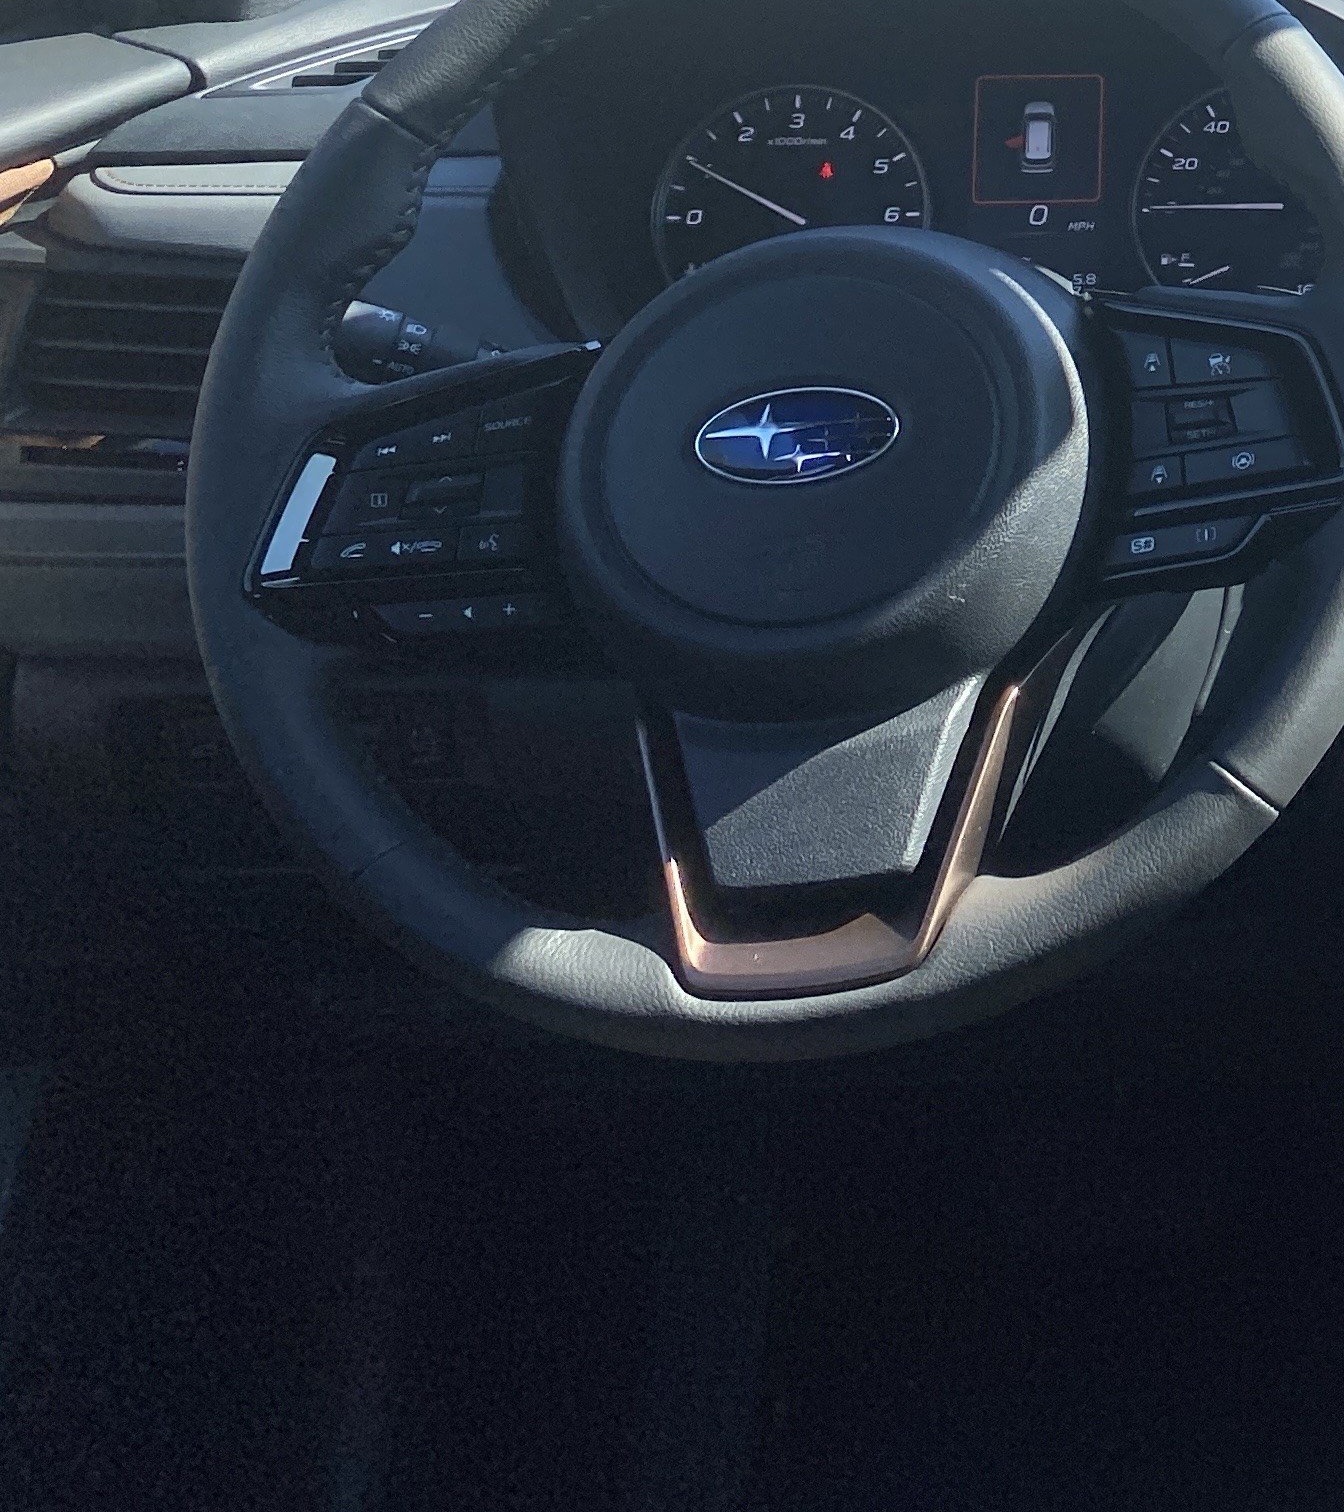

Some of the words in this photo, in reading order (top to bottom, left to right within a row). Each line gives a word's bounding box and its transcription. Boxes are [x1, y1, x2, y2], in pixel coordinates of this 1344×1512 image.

[788, 113, 806, 129] 3
[1203, 120, 1230, 134] 40
[738, 127, 754, 142] 2
[839, 126, 855, 140] 4
[873, 158, 890, 174] 5
[1172, 157, 1199, 172] 20
[686, 209, 703, 225] 0
[884, 206, 901, 222] 6
[1029, 204, 1049, 226] 0
[1067, 221, 1096, 231] MPH
[484, 415, 532, 432] SOURCE
